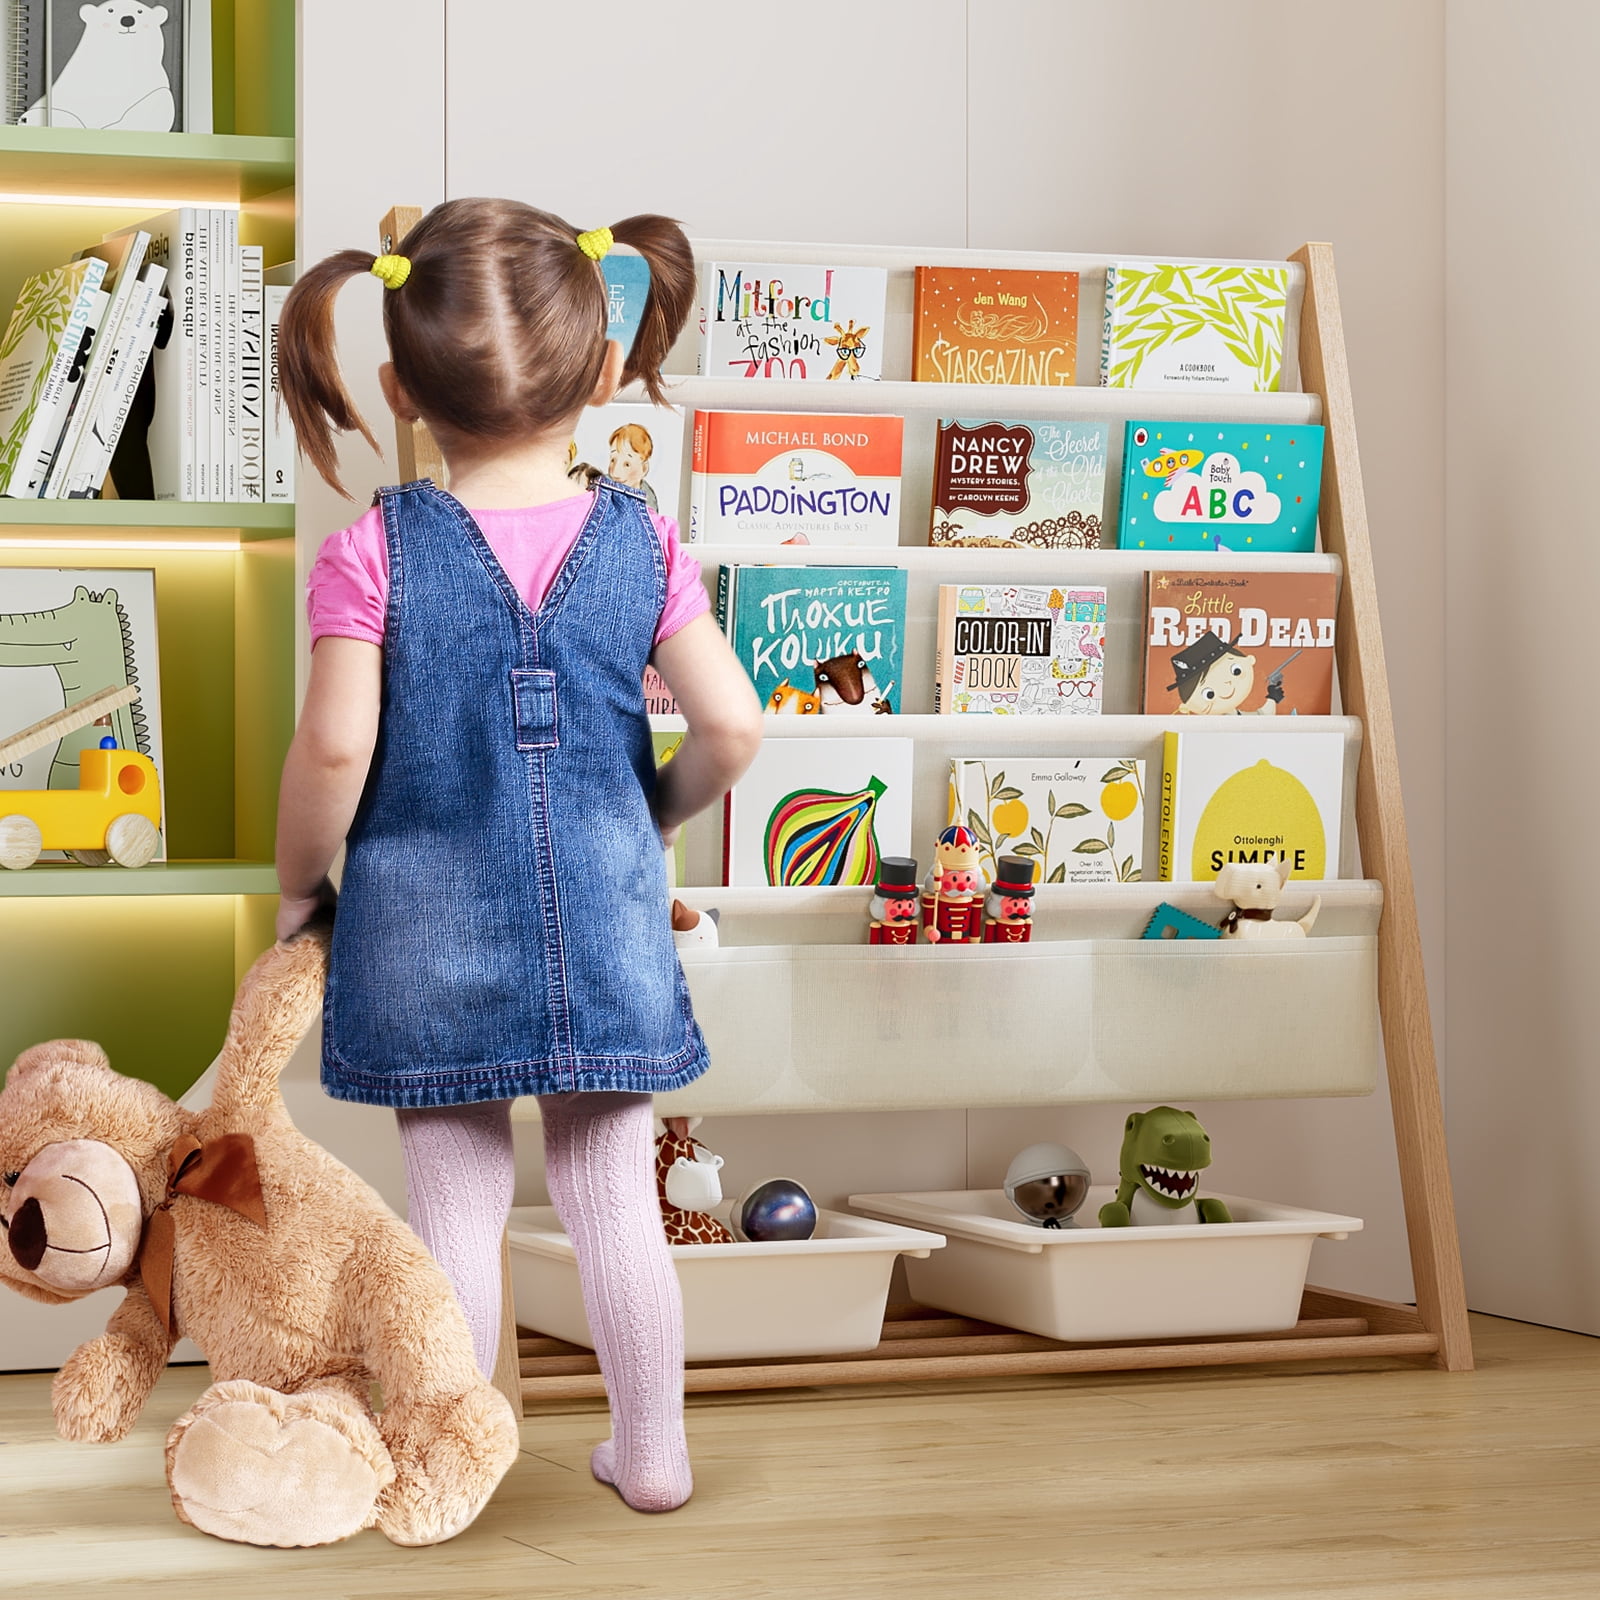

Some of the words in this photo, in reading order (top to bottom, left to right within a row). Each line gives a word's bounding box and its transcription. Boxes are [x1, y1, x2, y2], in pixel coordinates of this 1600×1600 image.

[715, 269, 835, 322] Mitford
[974, 292, 996, 305] Jen
[998, 292, 1028, 307] Wang
[60, 261, 105, 353] FALASTIN
[736, 320, 752, 337] at
[761, 316, 788, 334] the
[742, 328, 820, 369] fashion
[52, 352, 65, 374] SAMI
[1185, 364, 1215, 372] COOKBOOK
[42, 372, 58, 402] TAMIMI
[52, 376, 66, 405] WIGLEY
[746, 432, 817, 445] MICHAEL
[823, 433, 869, 446] BOND
[953, 437, 1025, 453] NANCY
[1039, 426, 1061, 443] The
[1045, 430, 1099, 461] Secret
[951, 455, 1024, 474] DREW
[1062, 454, 1104, 485] Old
[1210, 464, 1231, 475] Baby
[1210, 474, 1231, 483] Touch
[1043, 480, 1102, 514] Clock
[805, 587, 843, 598] МАРТА
[848, 586, 890, 596] КЕТРО
[1184, 591, 1234, 616] Little
[1150, 606, 1231, 646] RED
[1238, 608, 1335, 647] DEAD
[968, 658, 1018, 688] BOOK
[1031, 773, 1052, 781] Emma
[1054, 773, 1086, 782] Galloway
[1160, 772, 1172, 879] OTTOLENGH
[1233, 835, 1284, 846] Ottolenghi
